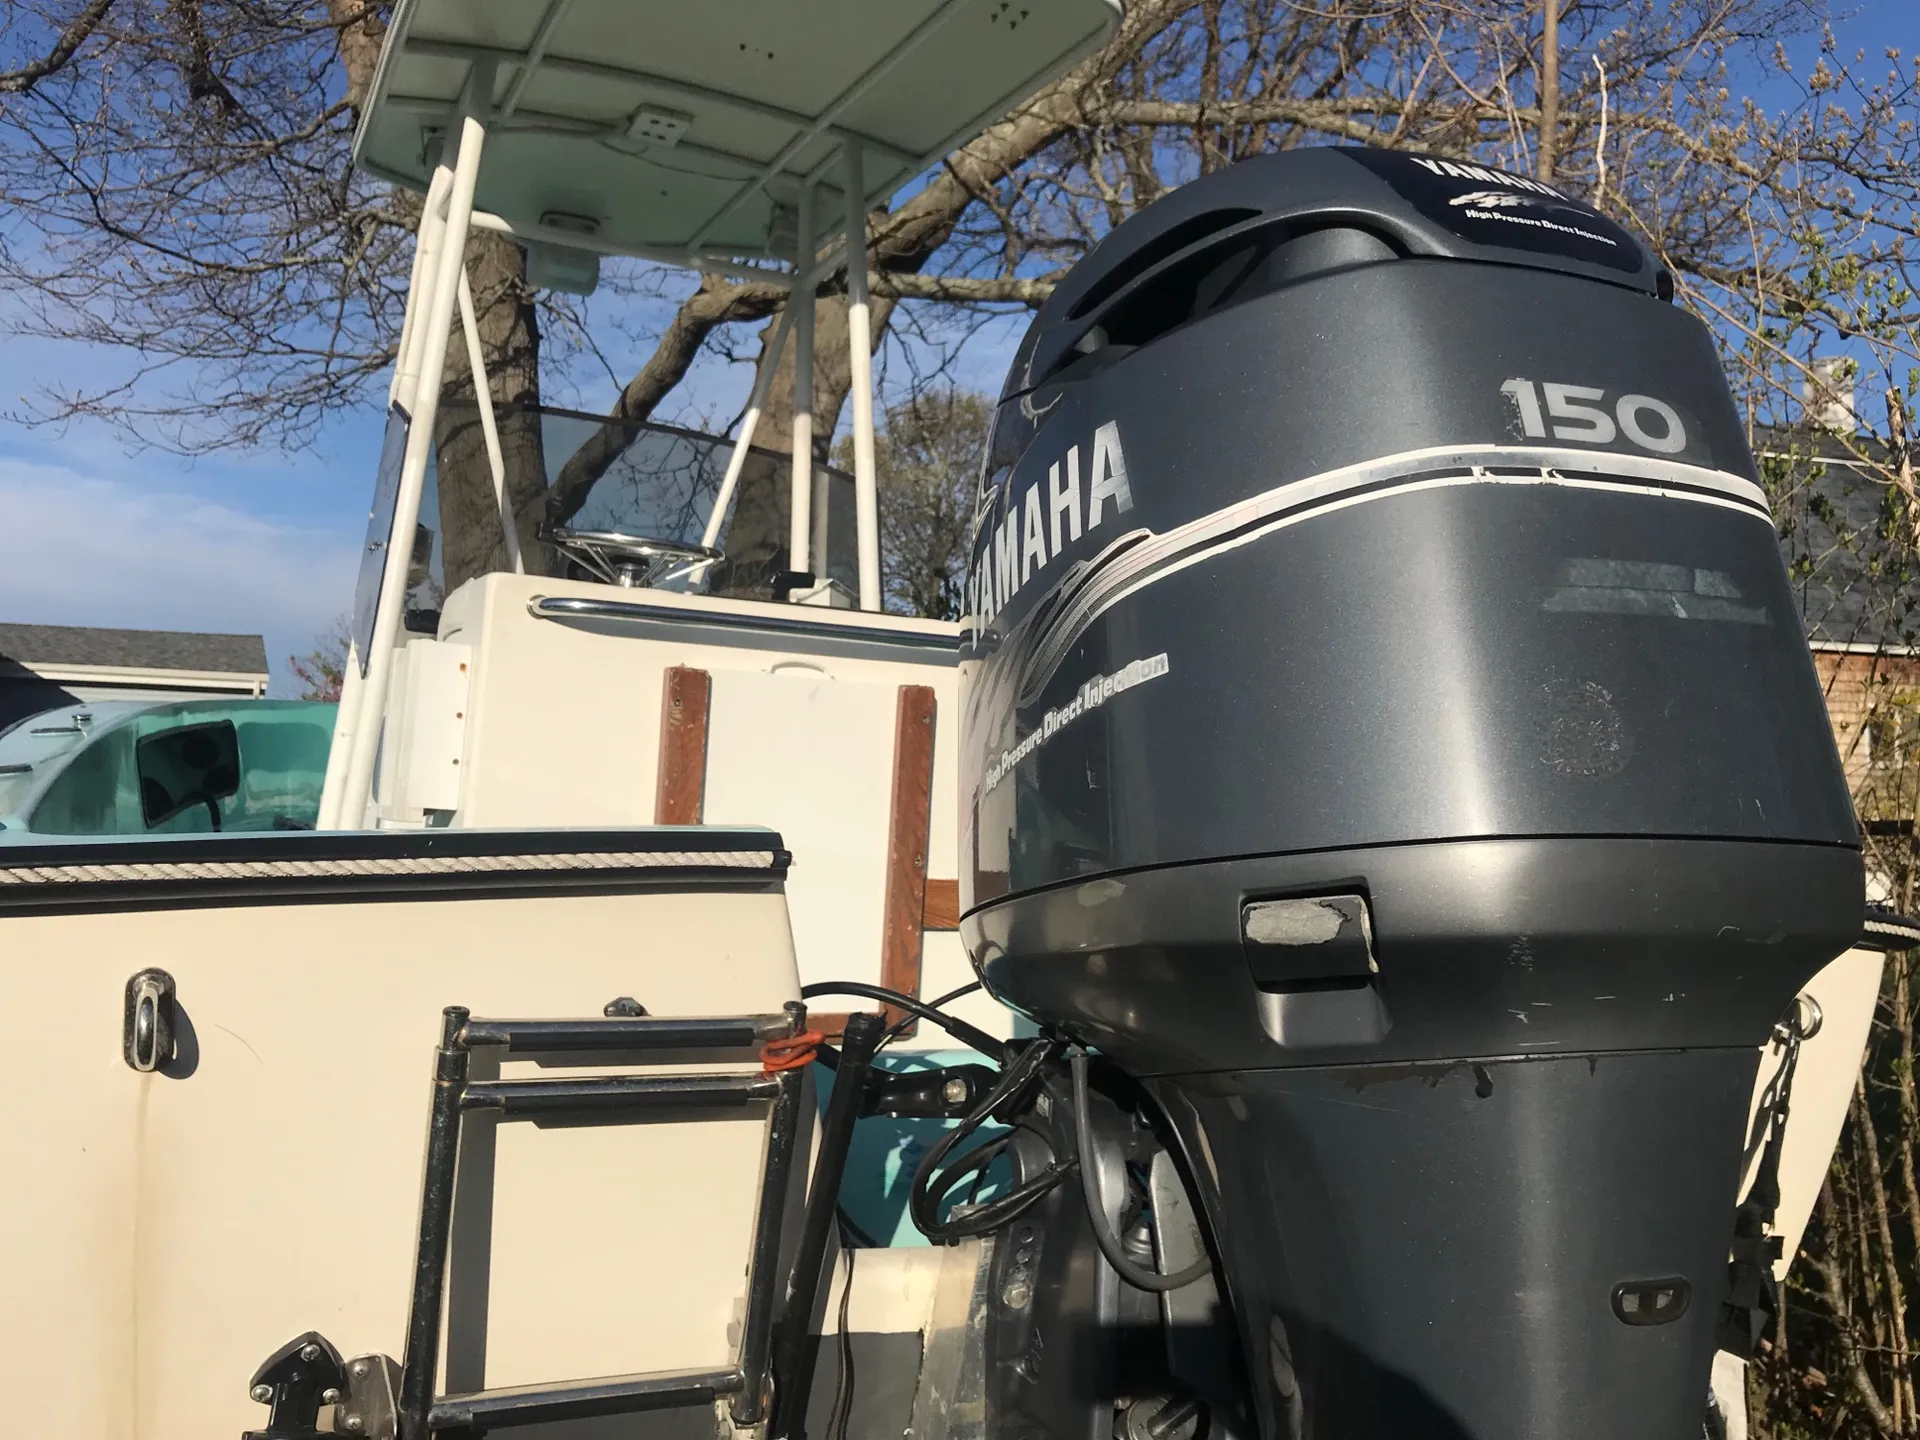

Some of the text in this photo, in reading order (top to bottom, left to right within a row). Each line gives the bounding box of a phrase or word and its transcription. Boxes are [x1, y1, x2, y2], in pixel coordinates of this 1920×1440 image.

[1409, 157, 1570, 202] YAMAHA
[1465, 208, 1618, 247] High Pressure Direct Injection
[1500, 377, 1687, 455] 150
[968, 420, 1135, 652] YAMAHA
[1001, 726, 1043, 776] Pressure
[1043, 695, 1083, 740] Direct
